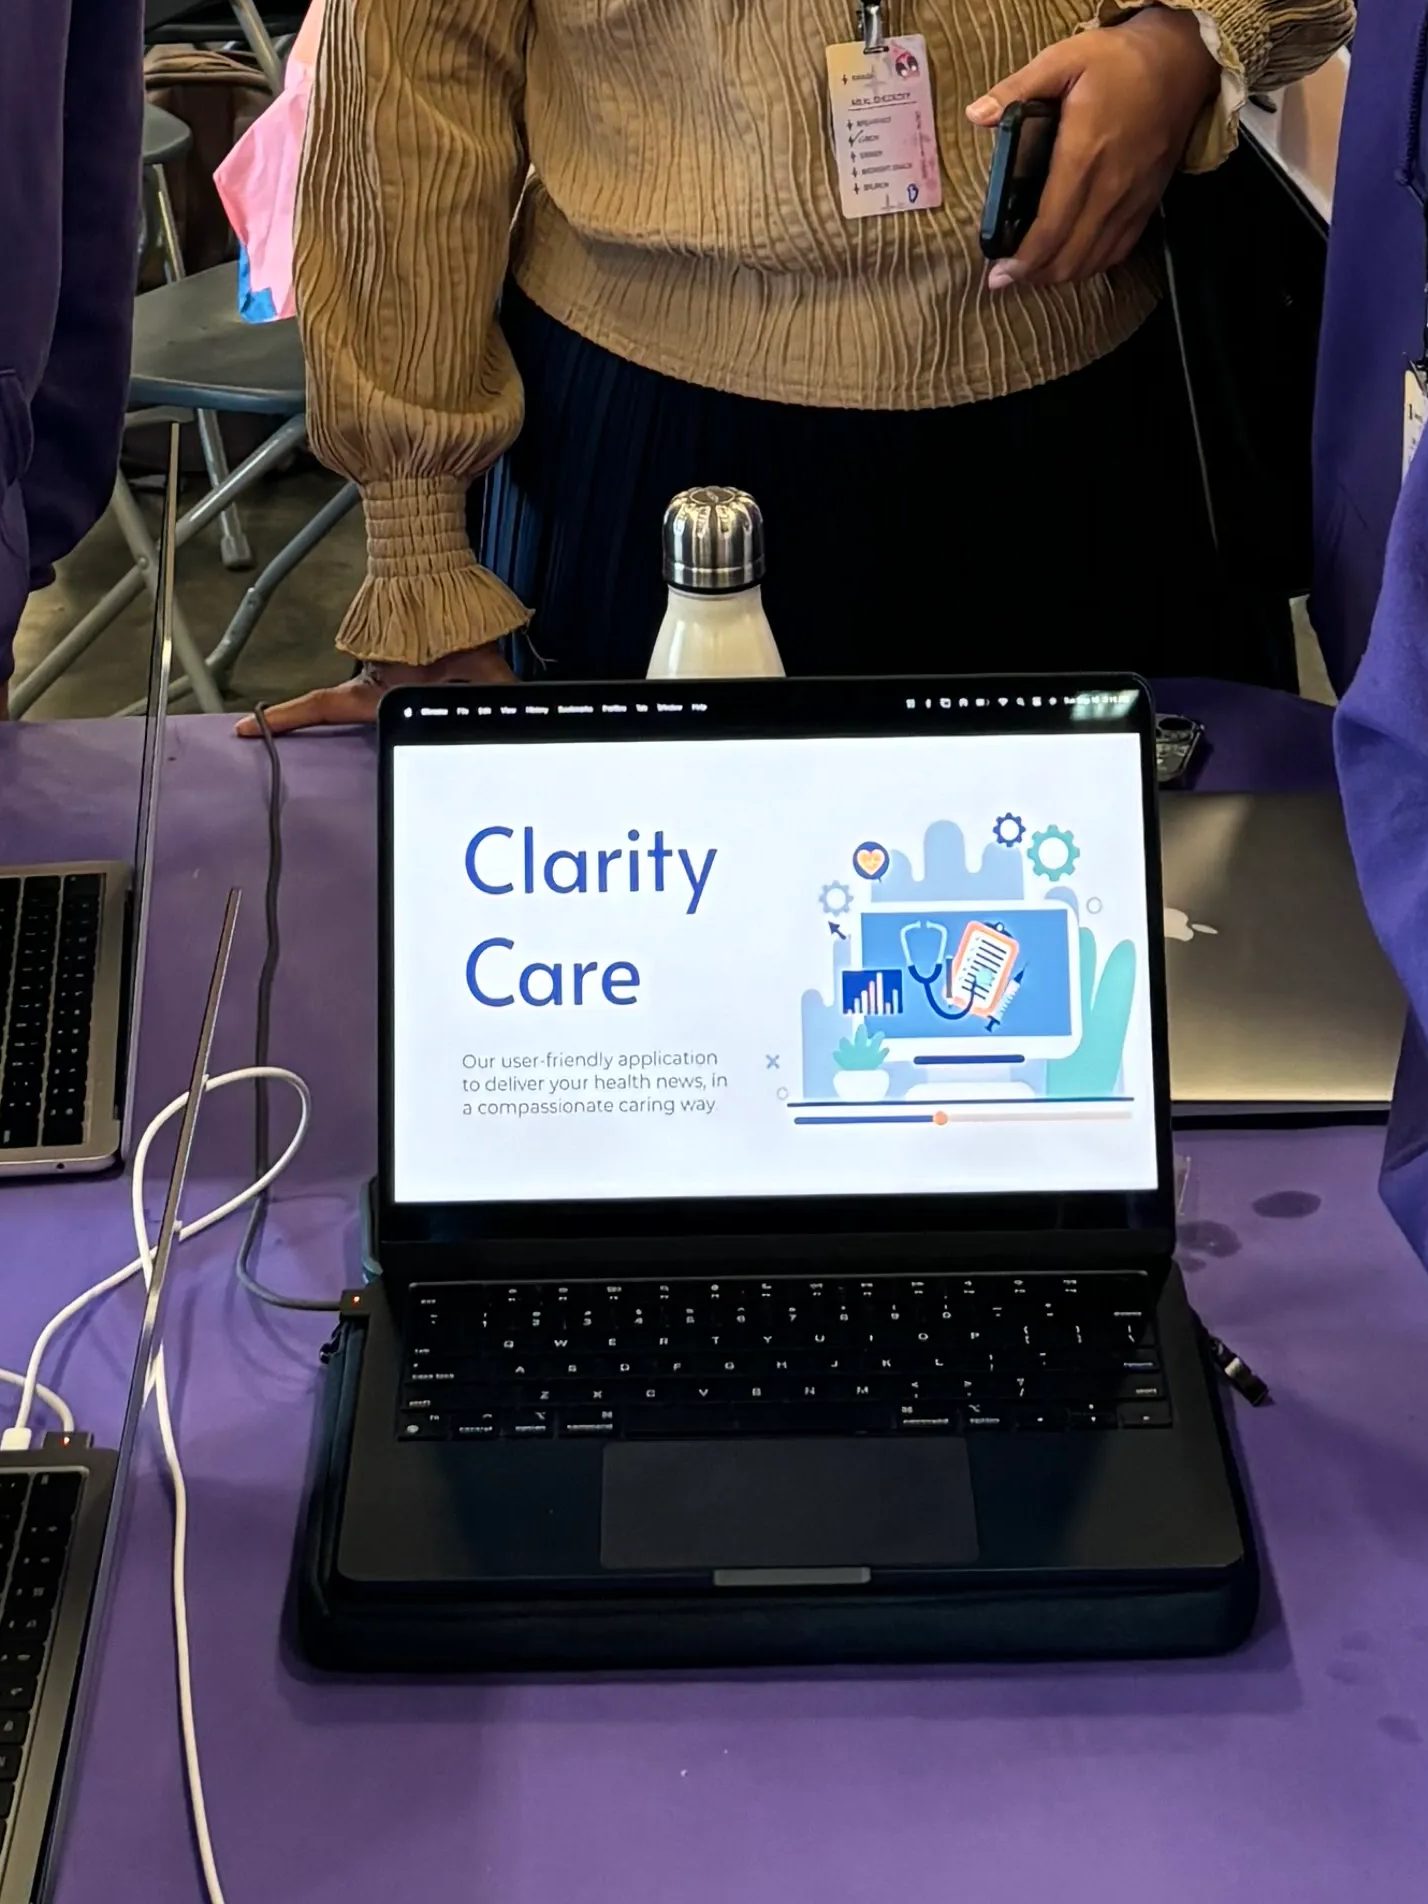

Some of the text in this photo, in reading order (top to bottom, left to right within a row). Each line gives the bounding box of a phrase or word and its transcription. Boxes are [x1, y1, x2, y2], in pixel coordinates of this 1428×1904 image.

[465, 825, 718, 915] Clarity
[465, 936, 641, 1008] Care
[462, 1050, 718, 1071] Our user-friendly application
[462, 1072, 729, 1095] to deliver your health news, in
[462, 1102, 473, 1116] a
[477, 1098, 614, 1119] compassionate
[618, 1097, 675, 1116] caring
